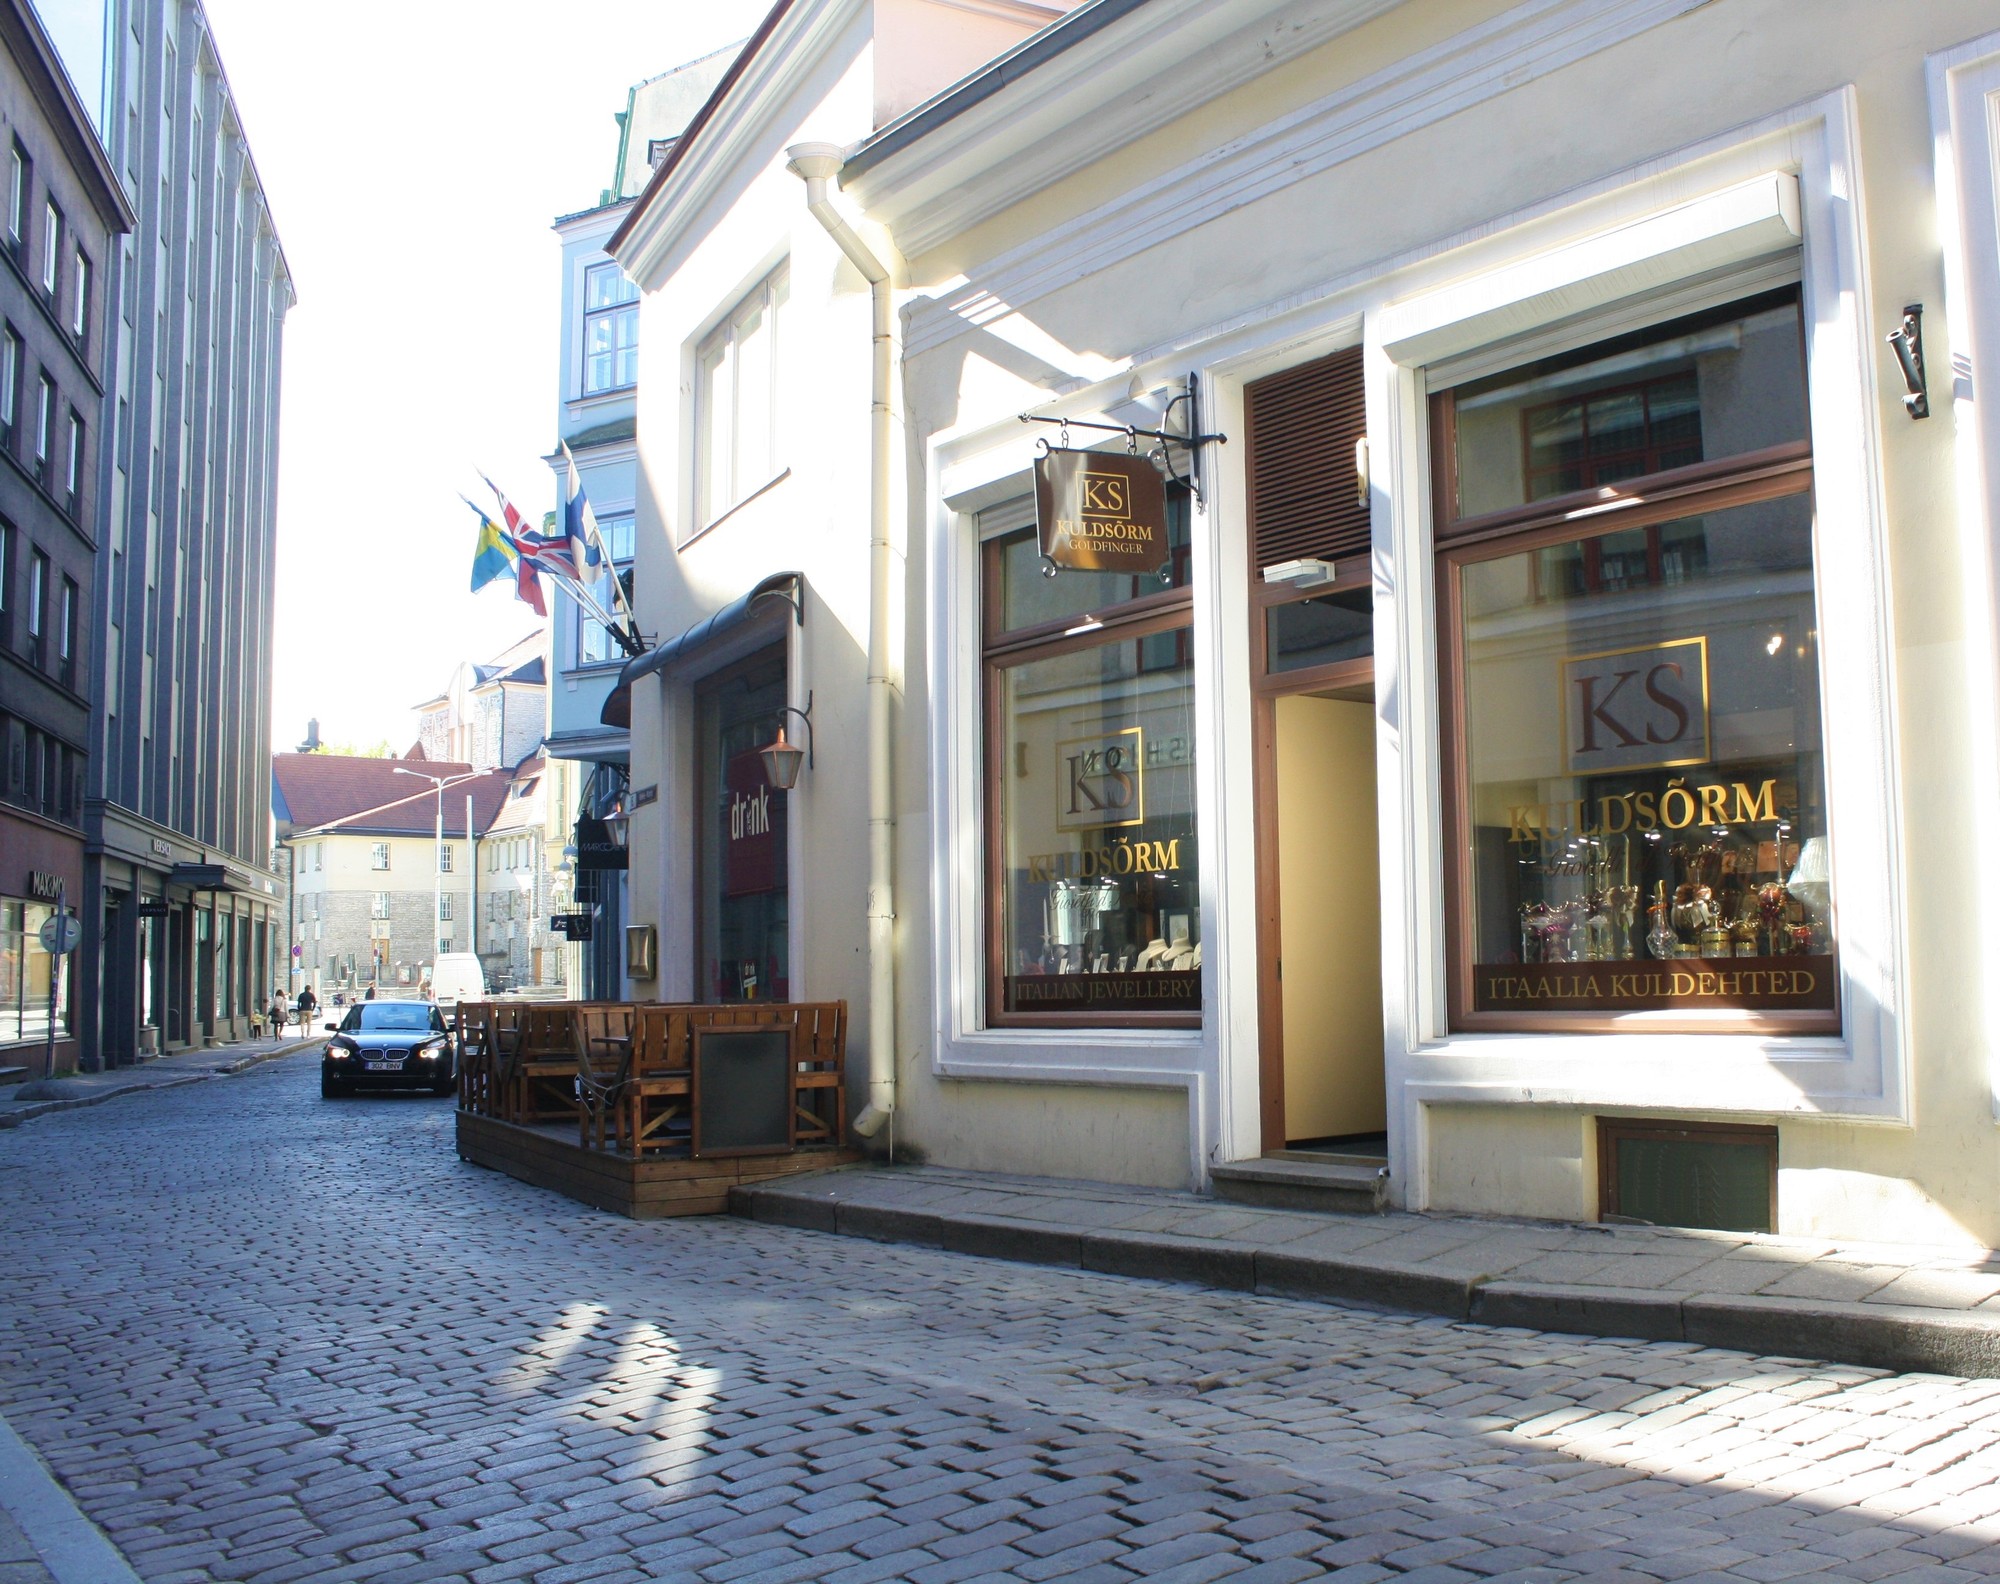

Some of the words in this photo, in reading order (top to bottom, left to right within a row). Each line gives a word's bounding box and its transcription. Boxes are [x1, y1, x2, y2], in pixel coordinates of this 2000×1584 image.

[1083, 479, 1123, 511] KS
[1056, 519, 1152, 541] KULDSÕRM
[1069, 538, 1144, 554] GOLDFINGER
[1573, 662, 1690, 753] KS
[1066, 745, 1133, 815] KS
[731, 784, 770, 841] drink
[1507, 777, 1780, 843] KULDSÕRM
[1027, 836, 1180, 884] KULDSÕRM
[1016, 982, 1084, 1001] ITALIAN
[1087, 979, 1196, 1004] JEWELLERY
[1489, 974, 1603, 999] ITAALIA
[1610, 970, 1816, 998] KULDEHTED
